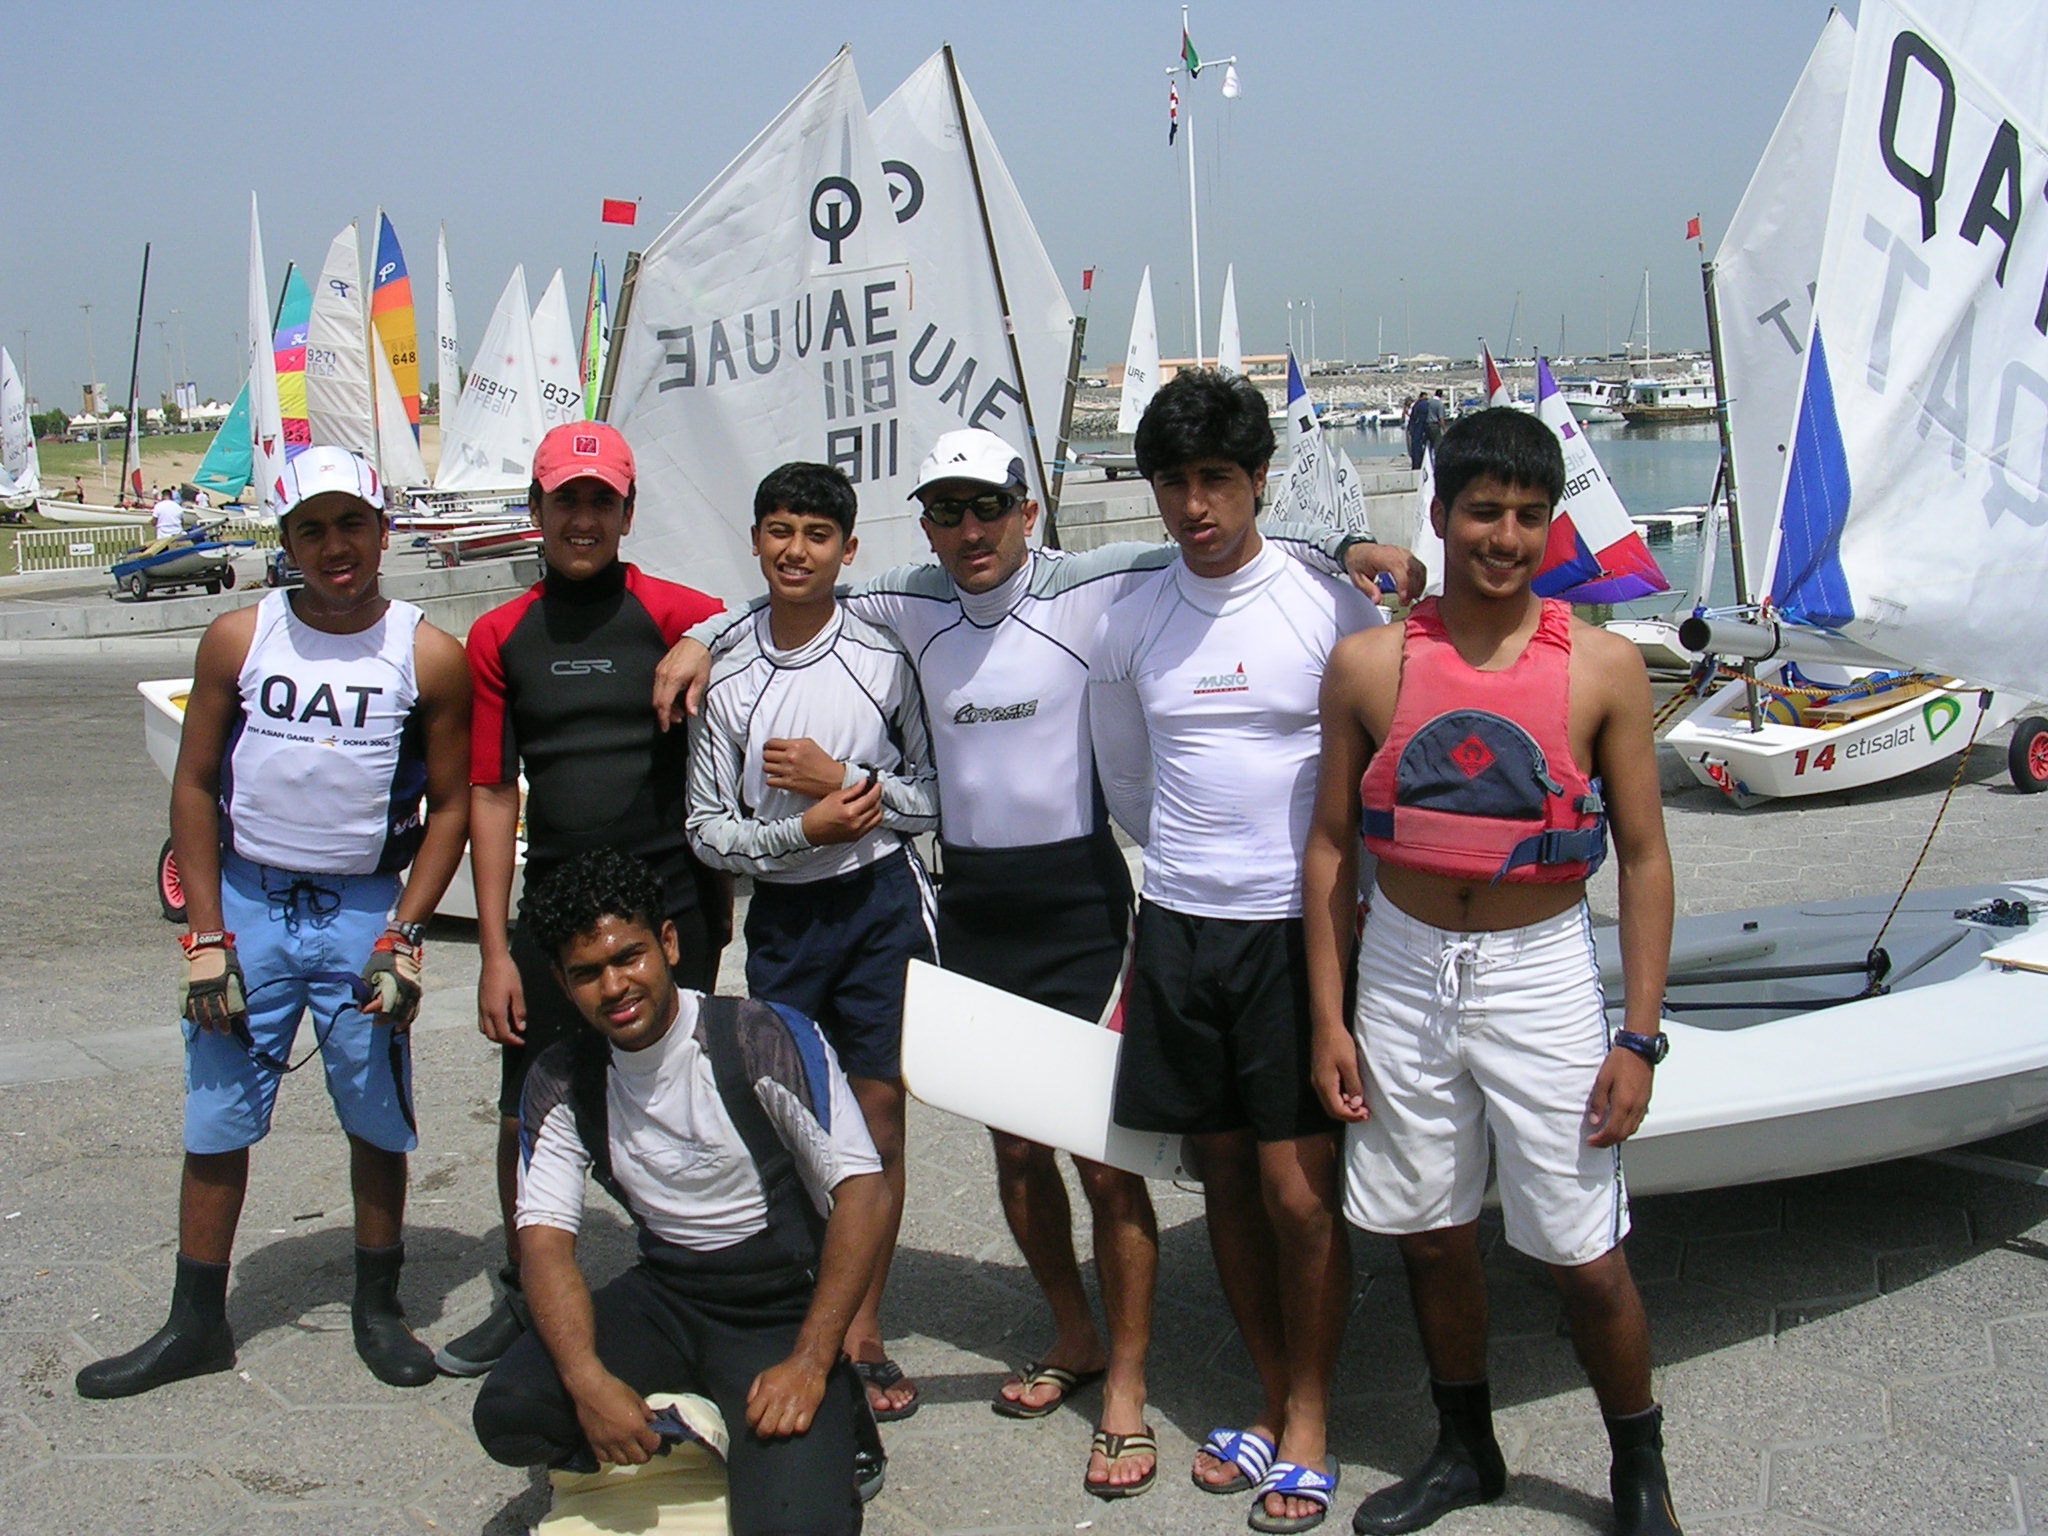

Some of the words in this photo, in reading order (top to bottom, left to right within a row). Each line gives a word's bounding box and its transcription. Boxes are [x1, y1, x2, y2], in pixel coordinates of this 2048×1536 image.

[794, 280, 898, 358] UAE
[307, 348, 337, 364] 9271
[392, 351, 417, 366] 648
[540, 379, 581, 408] 837
[1196, 674, 1248, 689] MUSTO
[260, 674, 384, 729] QAT
[260, 728, 285, 739] ASIAN
[286, 732, 315, 744] GAMES
[343, 738, 368, 747] DOHA
[1794, 743, 1837, 776] 14
[1845, 723, 1916, 759] etisalat
